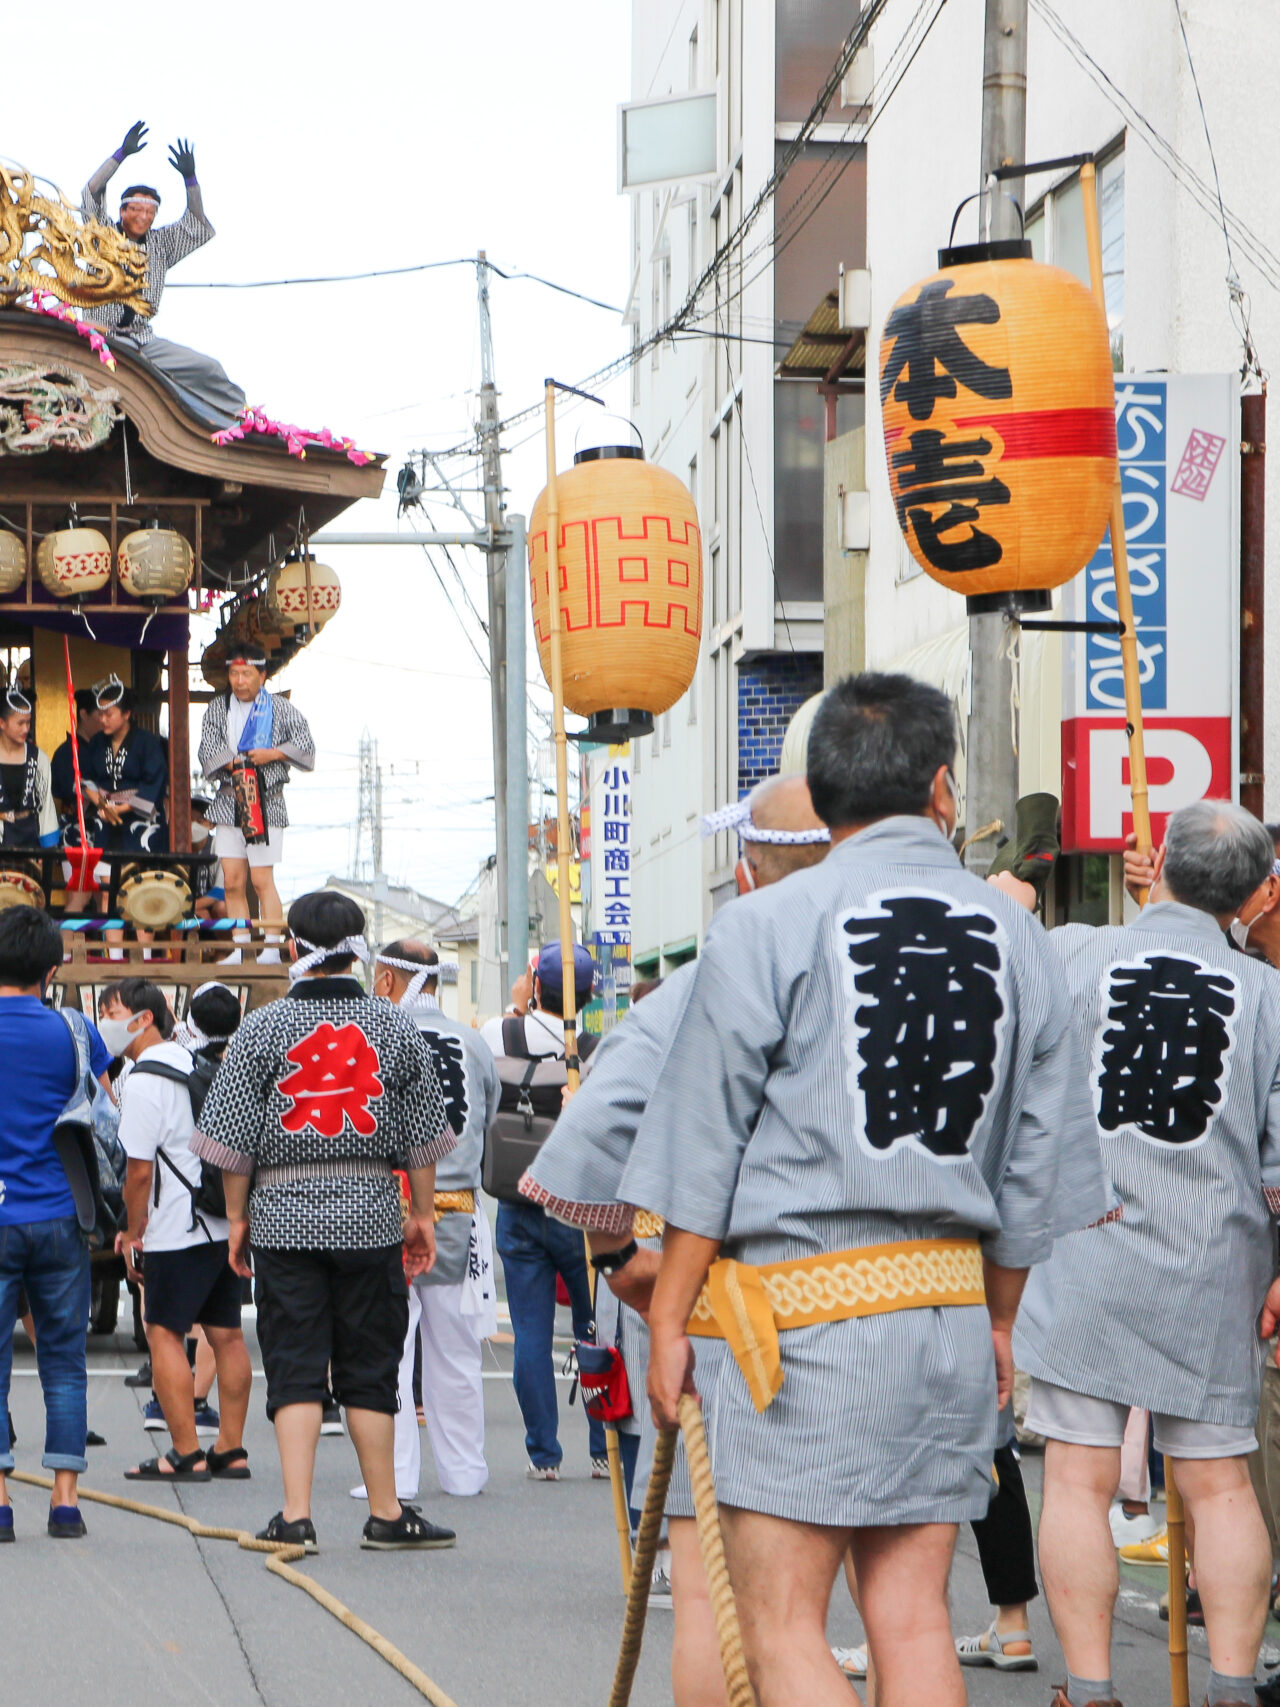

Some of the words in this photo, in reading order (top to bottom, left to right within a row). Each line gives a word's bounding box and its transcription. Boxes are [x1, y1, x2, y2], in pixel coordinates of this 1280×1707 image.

[1089, 729, 1213, 838] P
[603, 766, 631, 926] 小川町商工会
[600, 932, 616, 944] TEL
[277, 1020, 385, 1138] 祭
